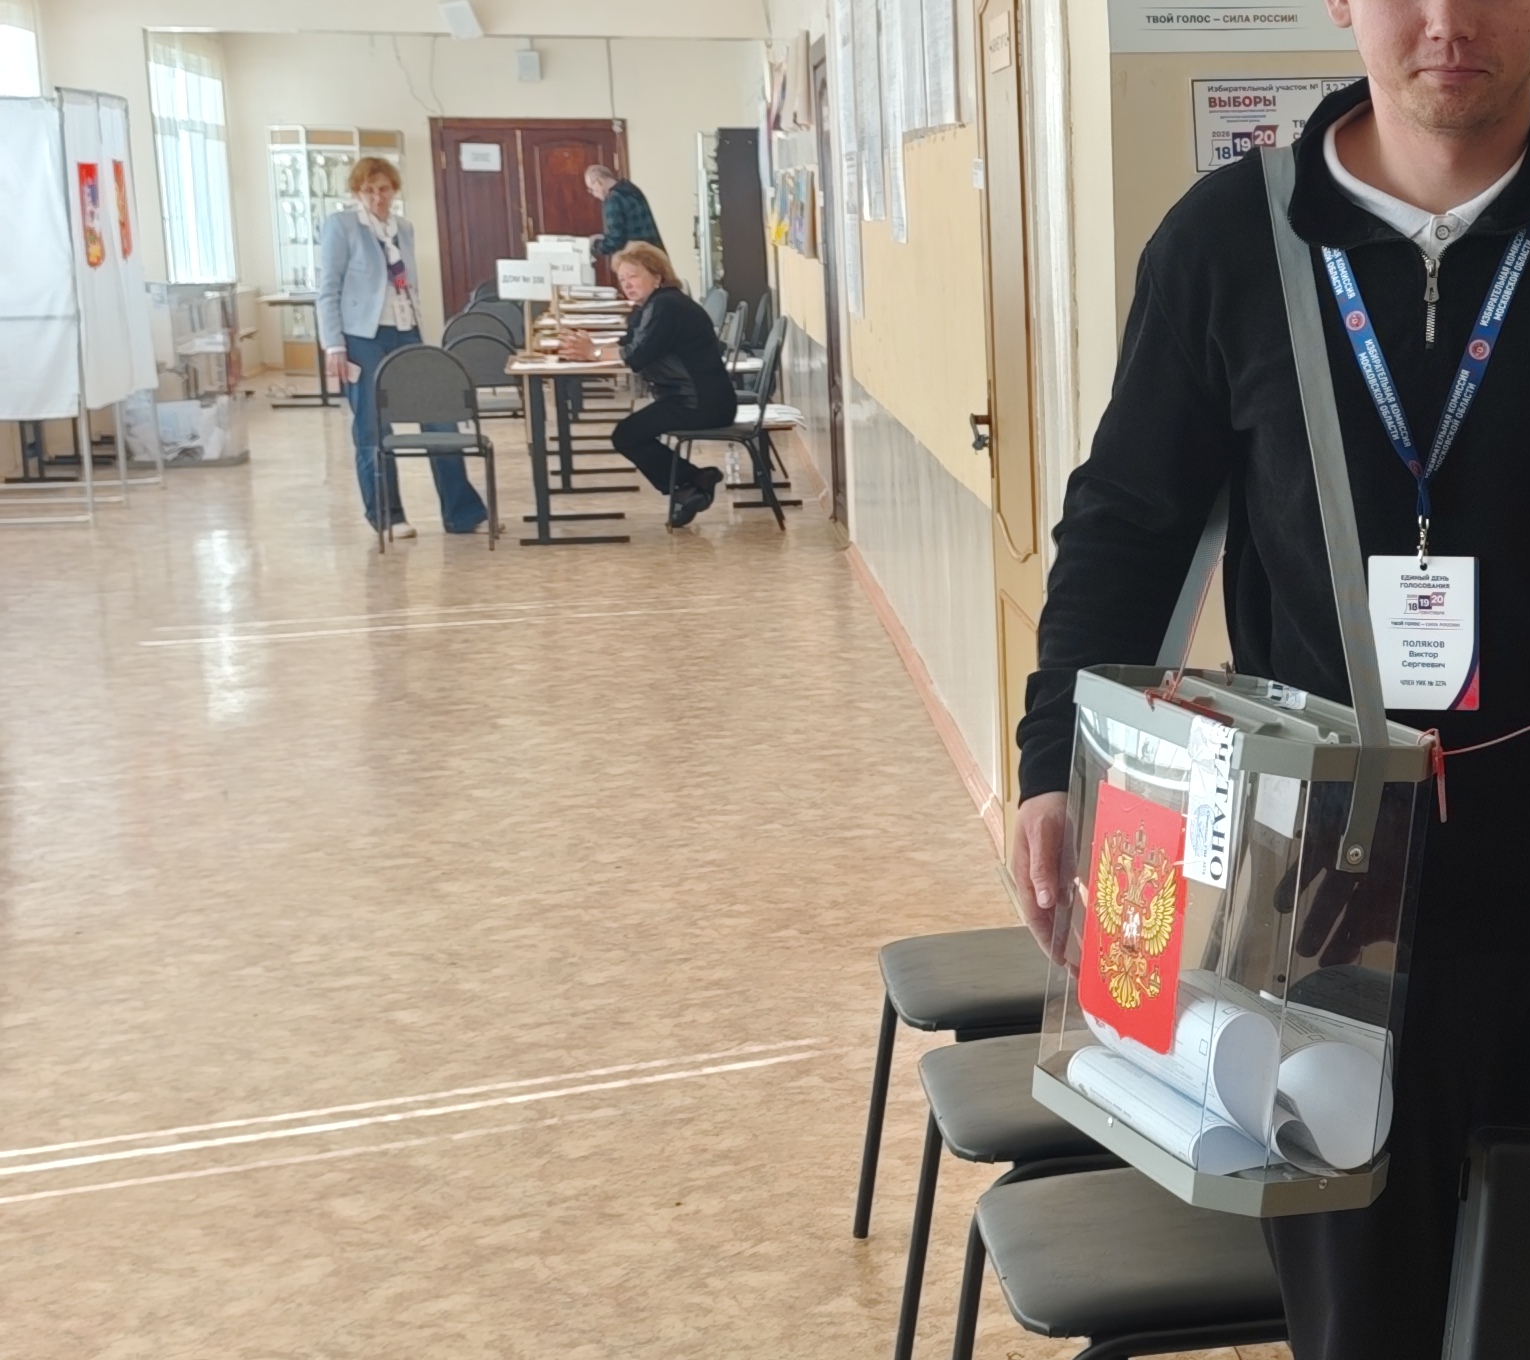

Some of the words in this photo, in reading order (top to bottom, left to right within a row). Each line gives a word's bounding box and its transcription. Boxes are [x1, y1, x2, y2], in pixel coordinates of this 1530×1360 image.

[1146, 13, 1174, 24] ТВОЙ
[1177, 15, 1211, 24] ГОЛОС
[1223, 14, 1251, 24] СИЛА
[1253, 14, 1299, 24] РОССИИ!
[1207, 84, 1274, 93] Избирательный
[1276, 84, 1308, 93] участок
[1208, 95, 1277, 109] ВЫБОРЫ
[1215, 146, 1232, 160] 18
[1234, 137, 1251, 153] 19
[1254, 130, 1275, 145] 20
[1328, 256, 1344, 296] ОБЛАСТИ
[1335, 255, 1356, 300] КОМИССИЯ
[1479, 264, 1510, 327] ИЗБИРАТЕЛЬНАЯ
[1493, 272, 1520, 322] МОСКОВСКОЙ
[1357, 352, 1387, 406] МОСКОВСКОЙ
[1379, 403, 1400, 441] ОБЛАСТИ
[1364, 338, 1395, 402] ИЗБИРАТЕЛЬНАЯ
[1390, 400, 1412, 448] КОМИССИЯ
[1448, 369, 1471, 416] КОМИССИЯ
[1457, 382, 1477, 421] ОБЛАСТИ
[1400, 573, 1430, 581] ЕДИНЫЙ
[1408, 603, 1418, 611] 18
[1419, 599, 1430, 608] 19
[1431, 595, 1444, 604] 20
[1402, 640, 1445, 649] ПОЛЯКОВ
[1408, 651, 1439, 660] Виктор
[1401, 660, 1446, 669] Сергеевич
